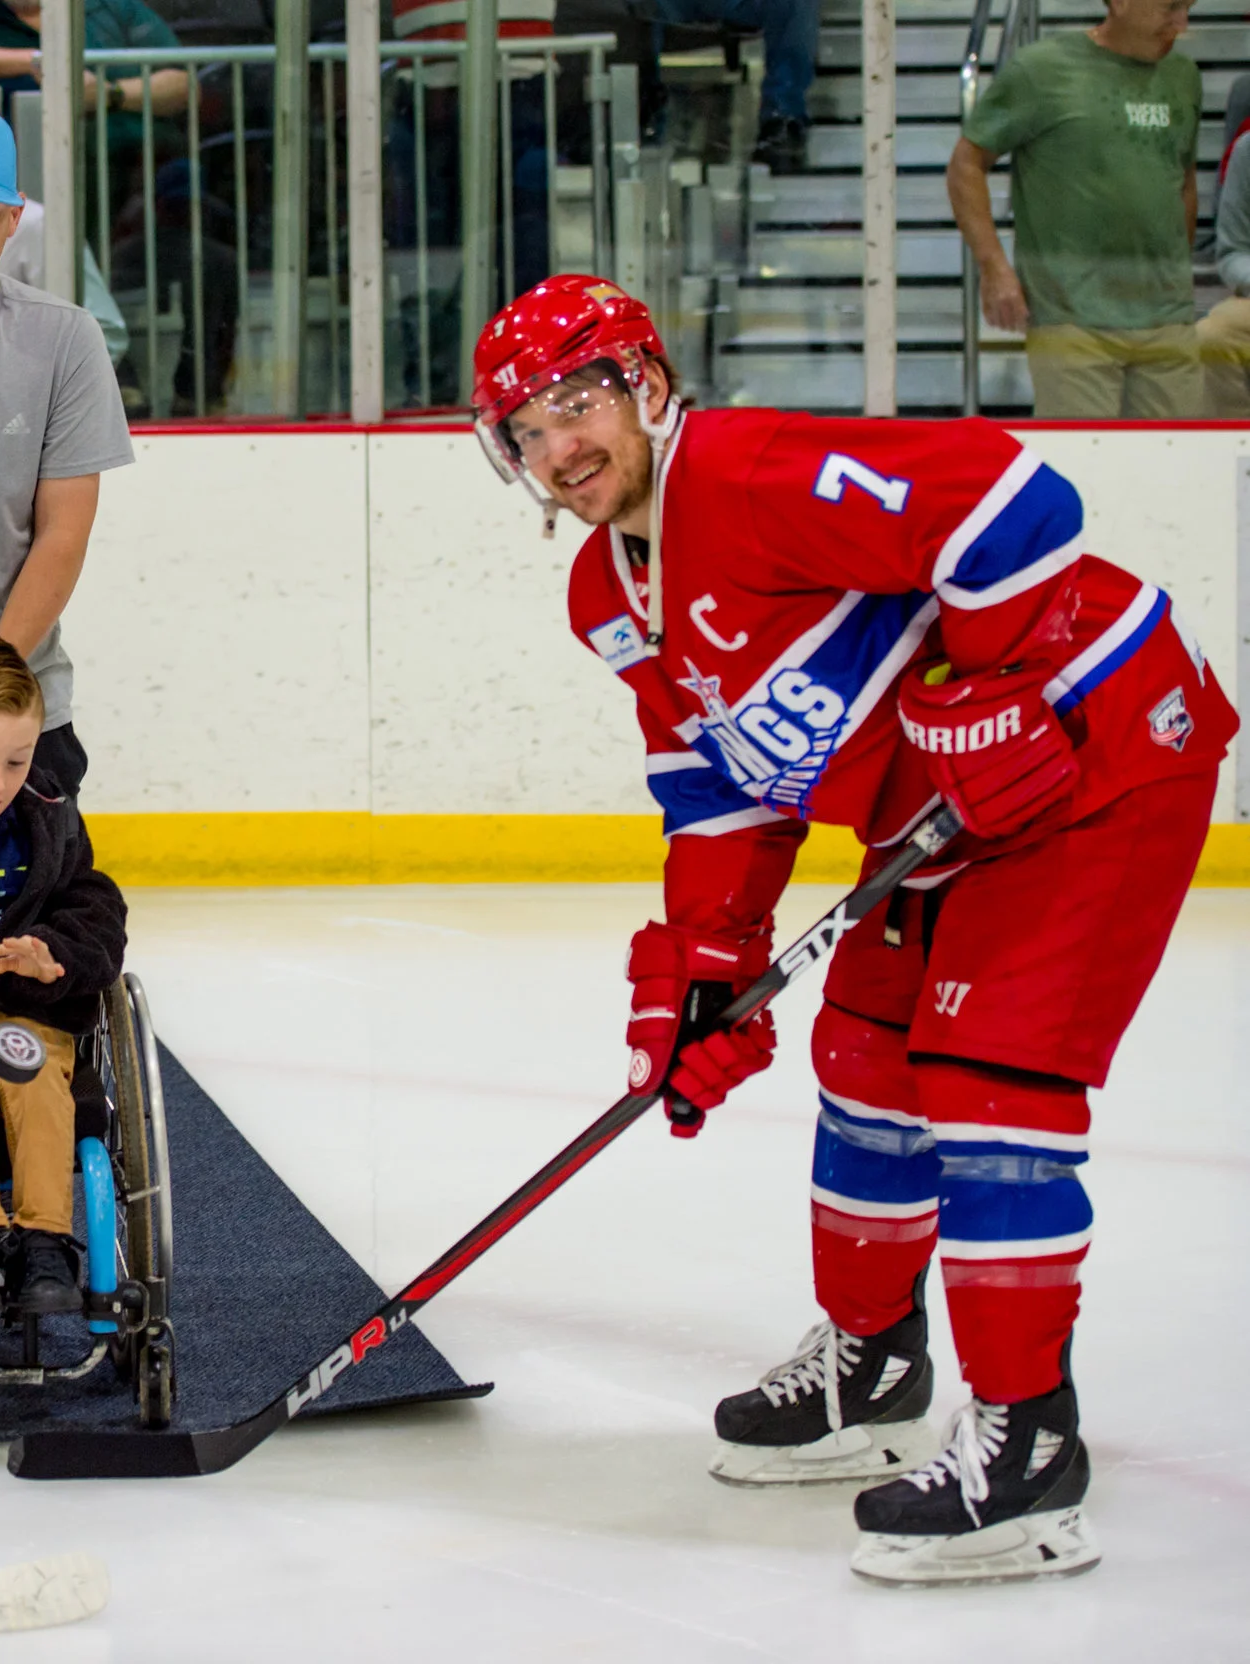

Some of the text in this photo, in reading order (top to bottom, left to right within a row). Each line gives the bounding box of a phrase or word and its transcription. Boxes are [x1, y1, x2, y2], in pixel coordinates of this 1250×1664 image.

[812, 451, 913, 514] 7
[689, 592, 750, 652] C
[777, 900, 862, 985] STX
[286, 1315, 388, 1420] HPR
